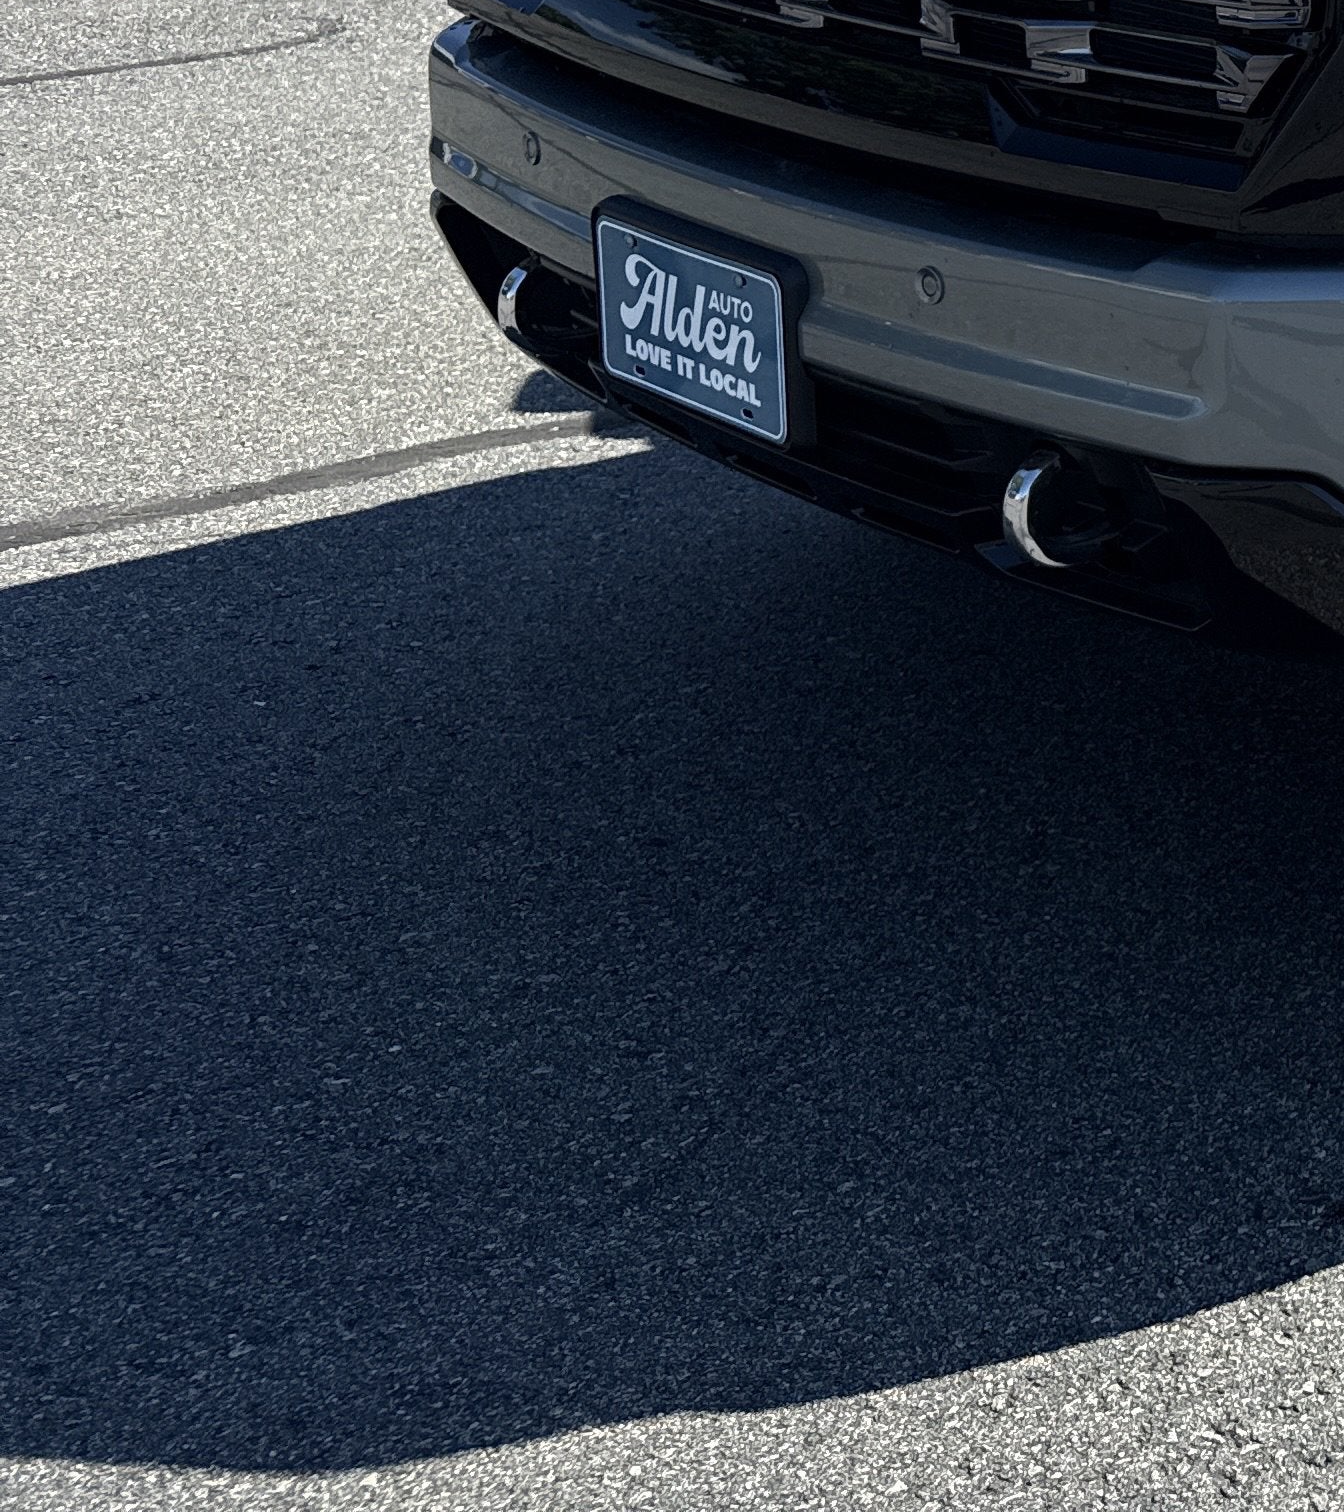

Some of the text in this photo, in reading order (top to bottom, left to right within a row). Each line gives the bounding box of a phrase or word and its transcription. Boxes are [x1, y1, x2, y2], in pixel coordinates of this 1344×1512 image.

[619, 253, 762, 374] Alden
[708, 289, 754, 323] AUTO
[624, 333, 762, 408] LOVE IT LOCAL
